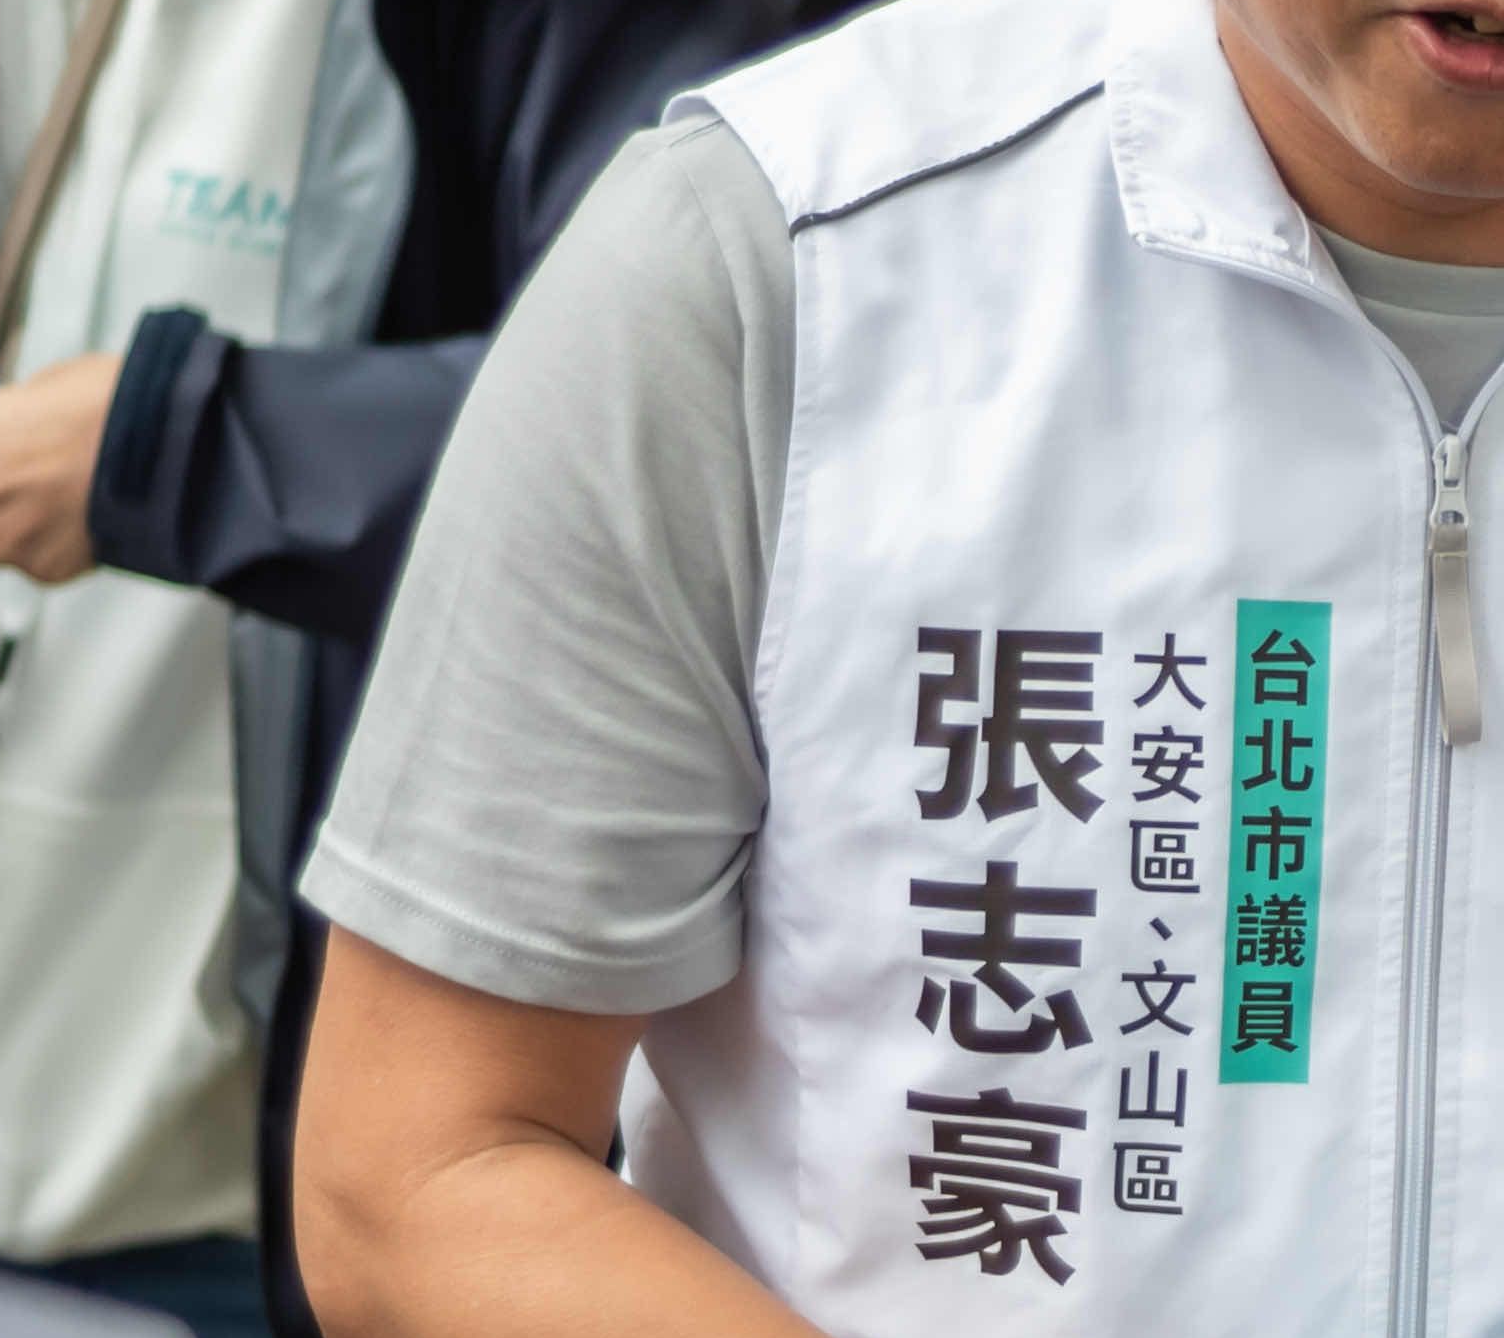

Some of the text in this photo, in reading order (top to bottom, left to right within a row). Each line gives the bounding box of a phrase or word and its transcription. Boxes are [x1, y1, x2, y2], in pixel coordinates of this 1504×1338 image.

[906, 627, 1105, 1287] 張志豪
[1113, 632, 1207, 1215] 大安區、文山區
[1230, 629, 1316, 1054] 台北市議員
